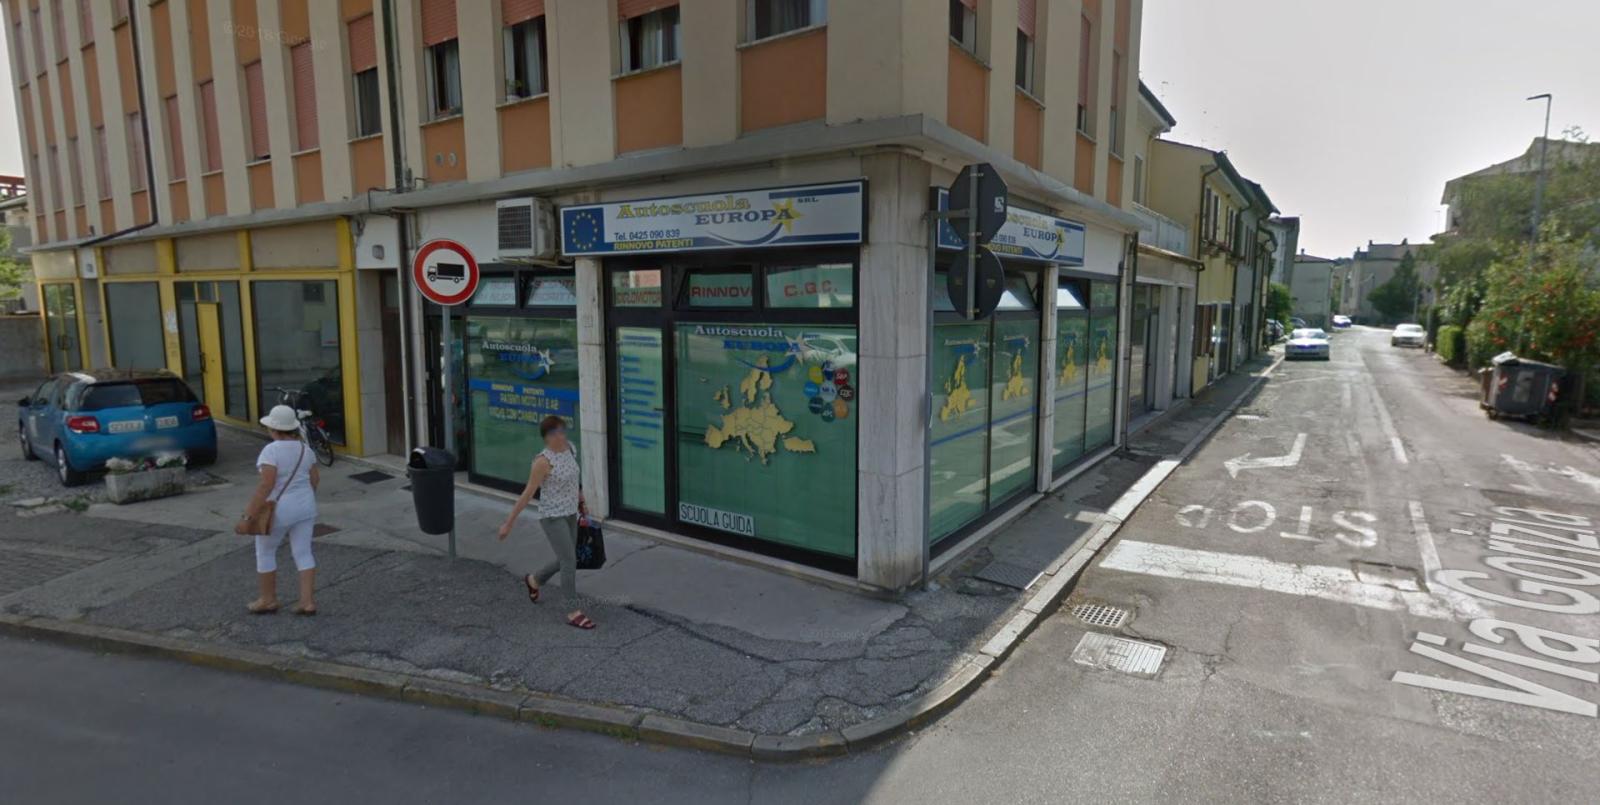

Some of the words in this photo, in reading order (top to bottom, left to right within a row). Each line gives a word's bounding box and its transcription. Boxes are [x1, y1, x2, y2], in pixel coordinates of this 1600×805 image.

[617, 195, 751, 219] Autoscuola
[695, 208, 794, 226] EUROPA
[614, 232, 627, 240] Tel.
[629, 230, 649, 240] 0425
[650, 229, 665, 238] 090
[1023, 227, 1064, 244] EUROPA
[614, 240, 654, 251] RINNOVO
[655, 238, 694, 249] PATENTI
[691, 286, 753, 298] RINNOV
[694, 325, 784, 339] Autoscuola
[482, 341, 537, 352] Autoscuola
[680, 504, 720, 527] SCUOLA
[722, 512, 753, 534] GUIDA
[1175, 500, 1379, 548] STOP
